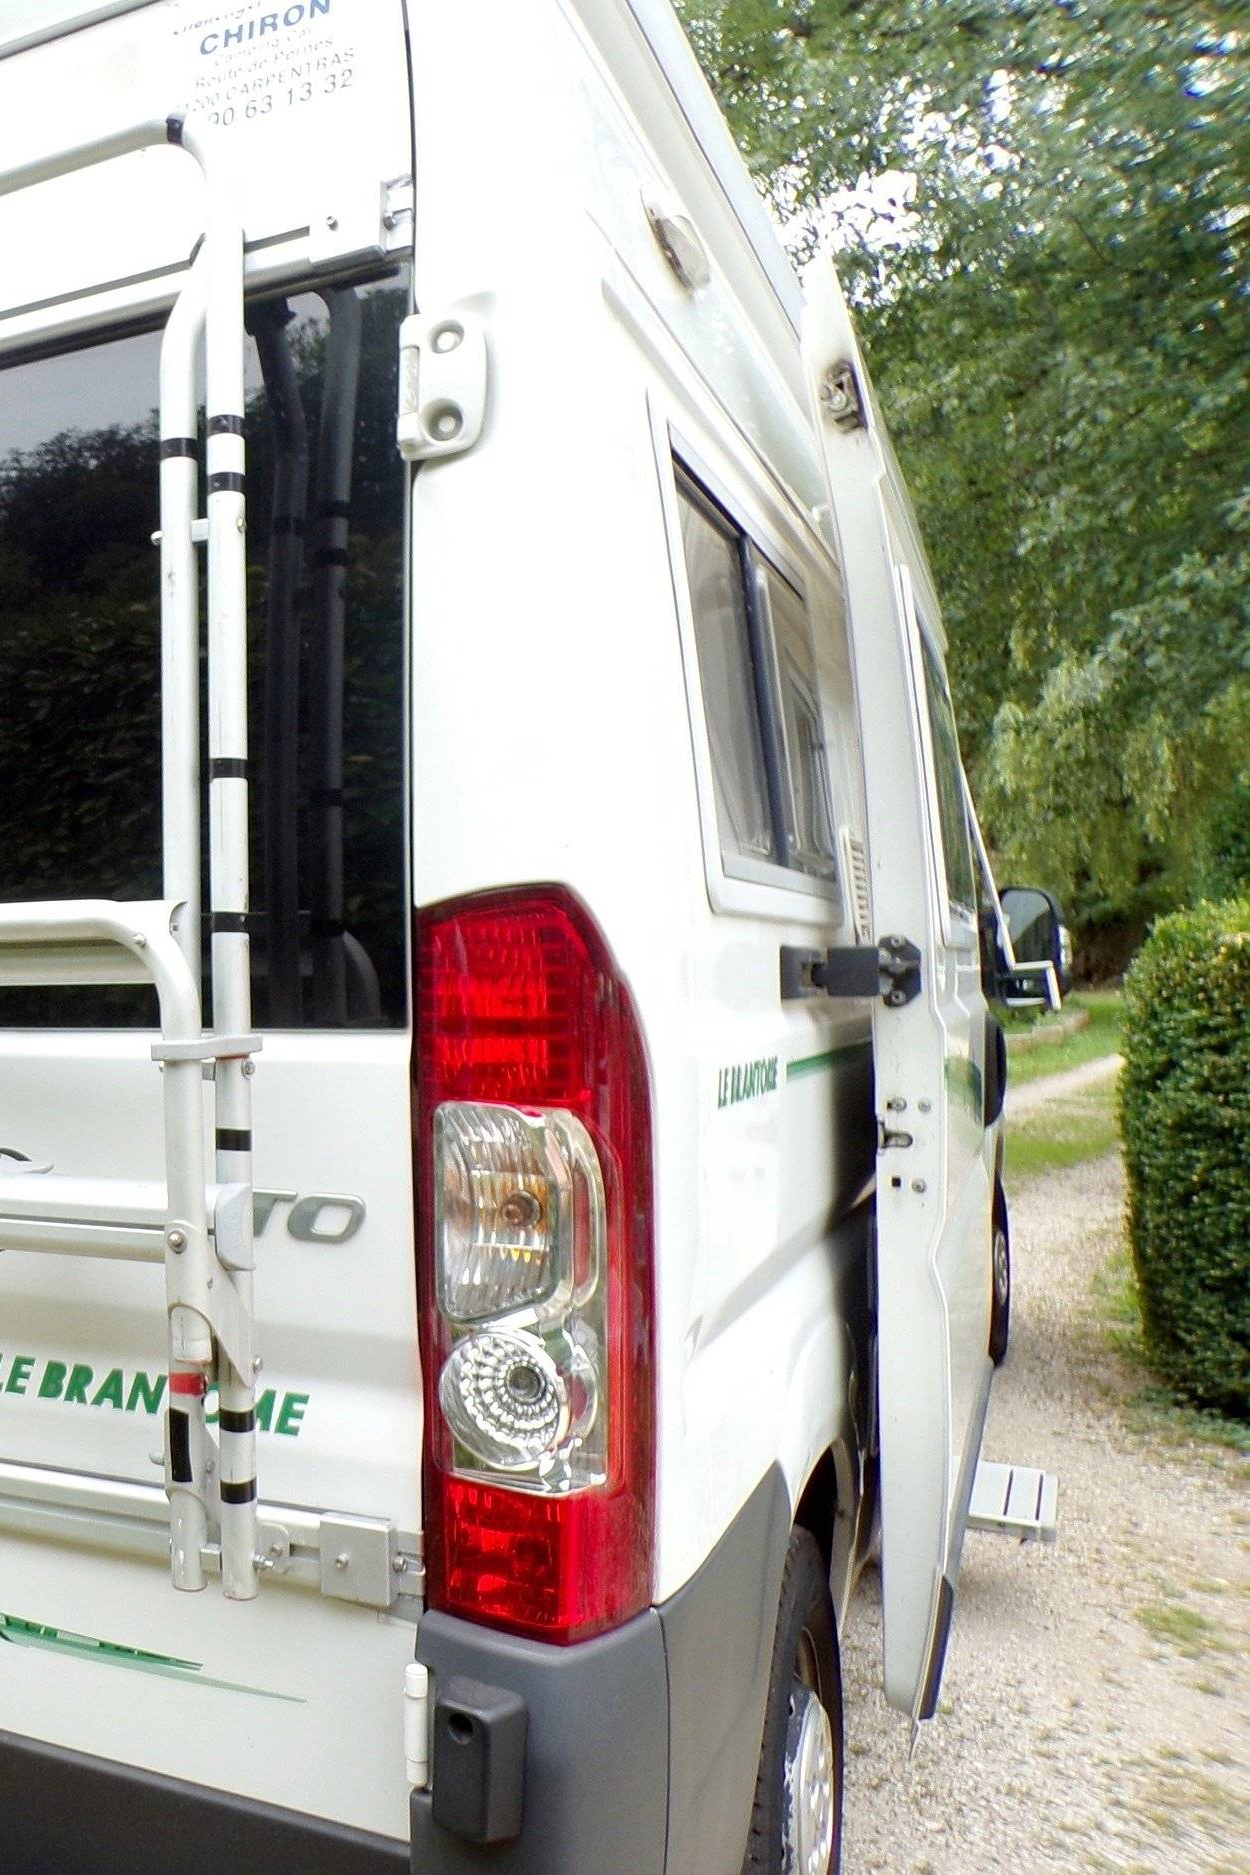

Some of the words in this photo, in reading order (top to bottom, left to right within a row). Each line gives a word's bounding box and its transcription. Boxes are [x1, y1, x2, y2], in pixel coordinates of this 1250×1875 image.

[200, 0, 331, 55] CHIRON
[245, 93, 273, 119] 63
[285, 82, 312, 106] 13
[323, 68, 354, 95] 32
